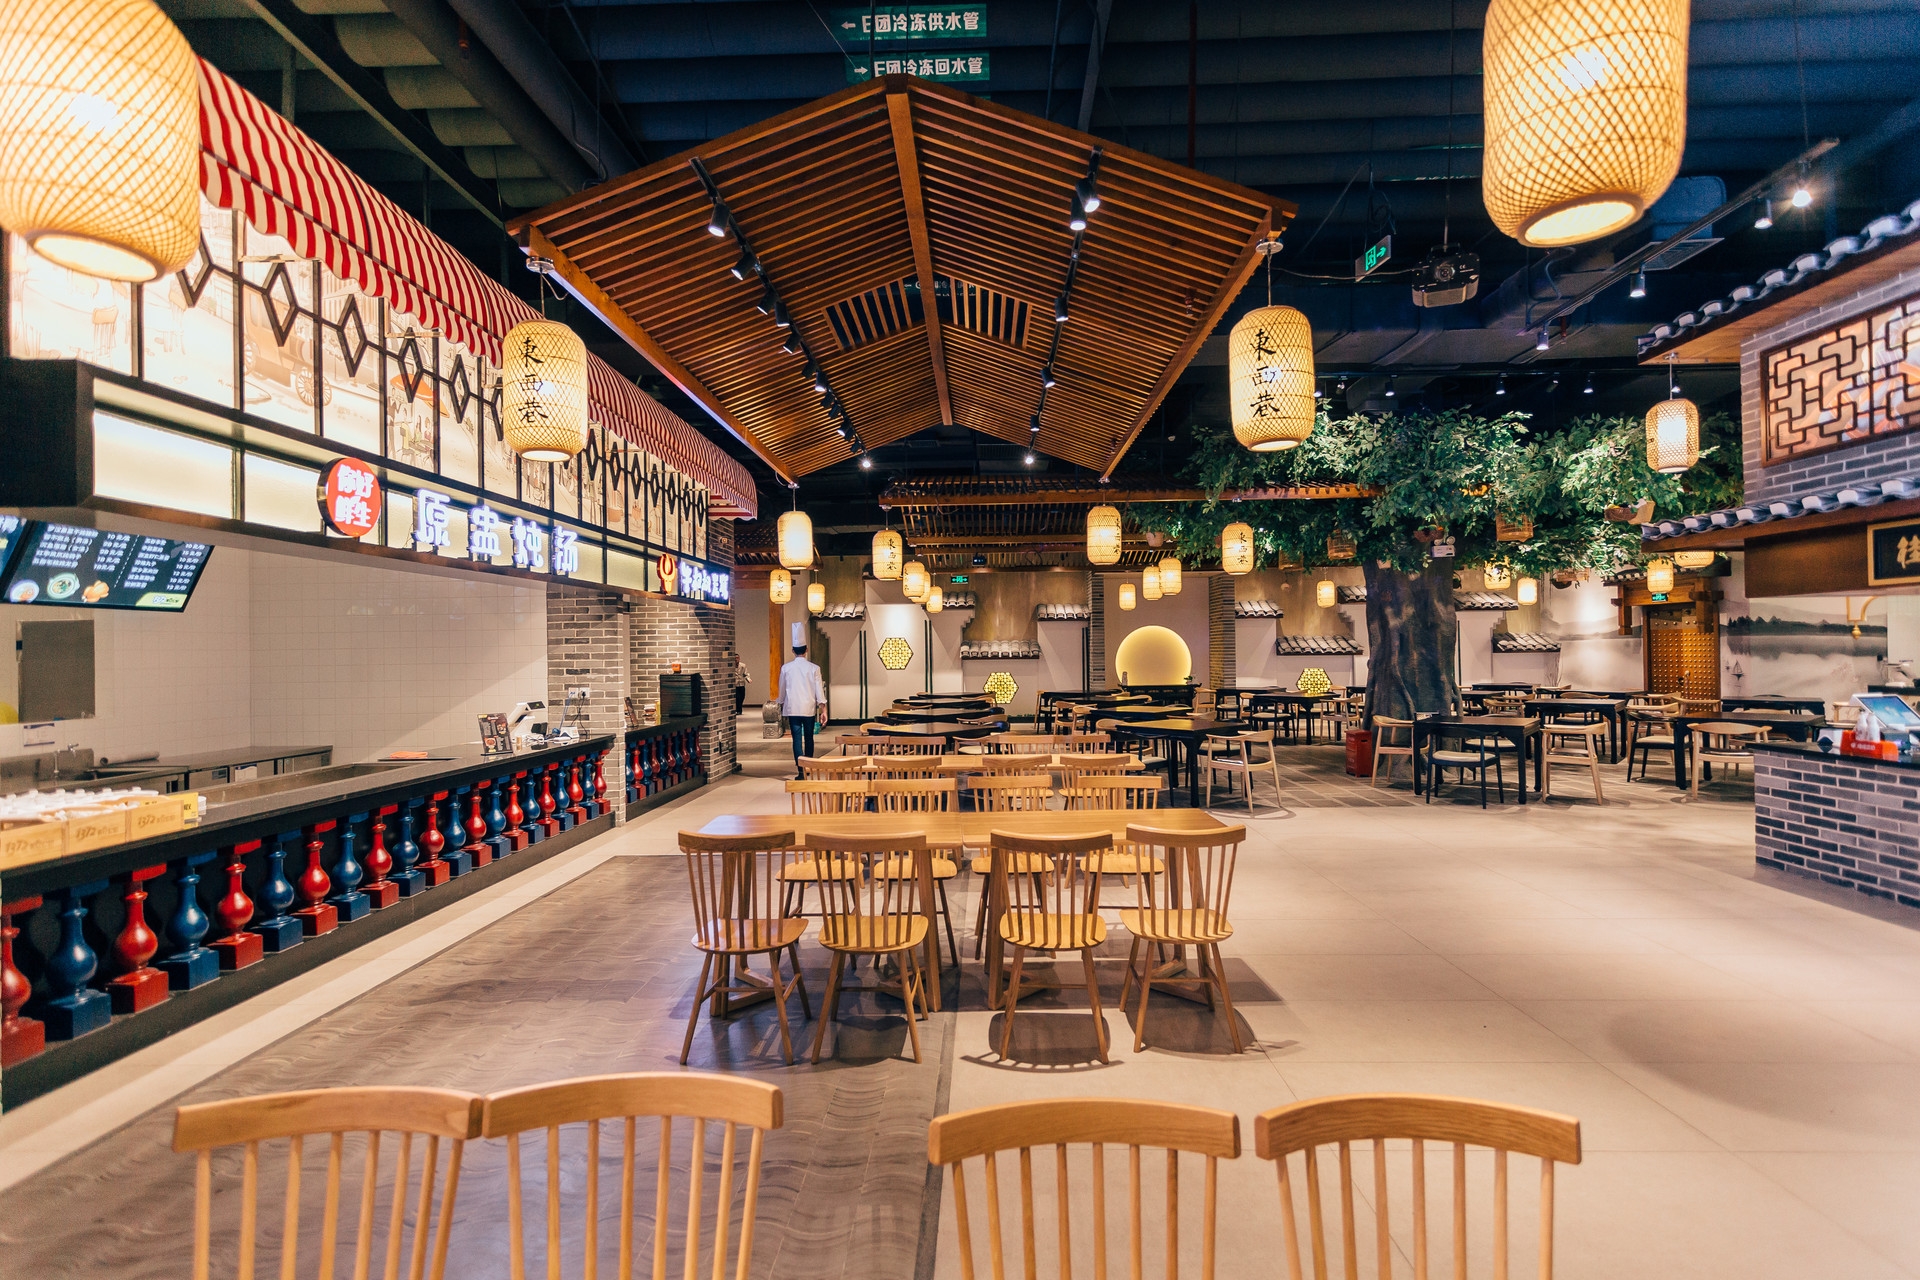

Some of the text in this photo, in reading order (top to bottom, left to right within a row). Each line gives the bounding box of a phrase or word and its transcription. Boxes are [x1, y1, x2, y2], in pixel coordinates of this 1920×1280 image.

[862, 12, 979, 32] E团冷冻供水管
[519, 337, 548, 423] 東西巷
[337, 464, 374, 498] 你好
[417, 489, 578, 573] 原盅炖汤
